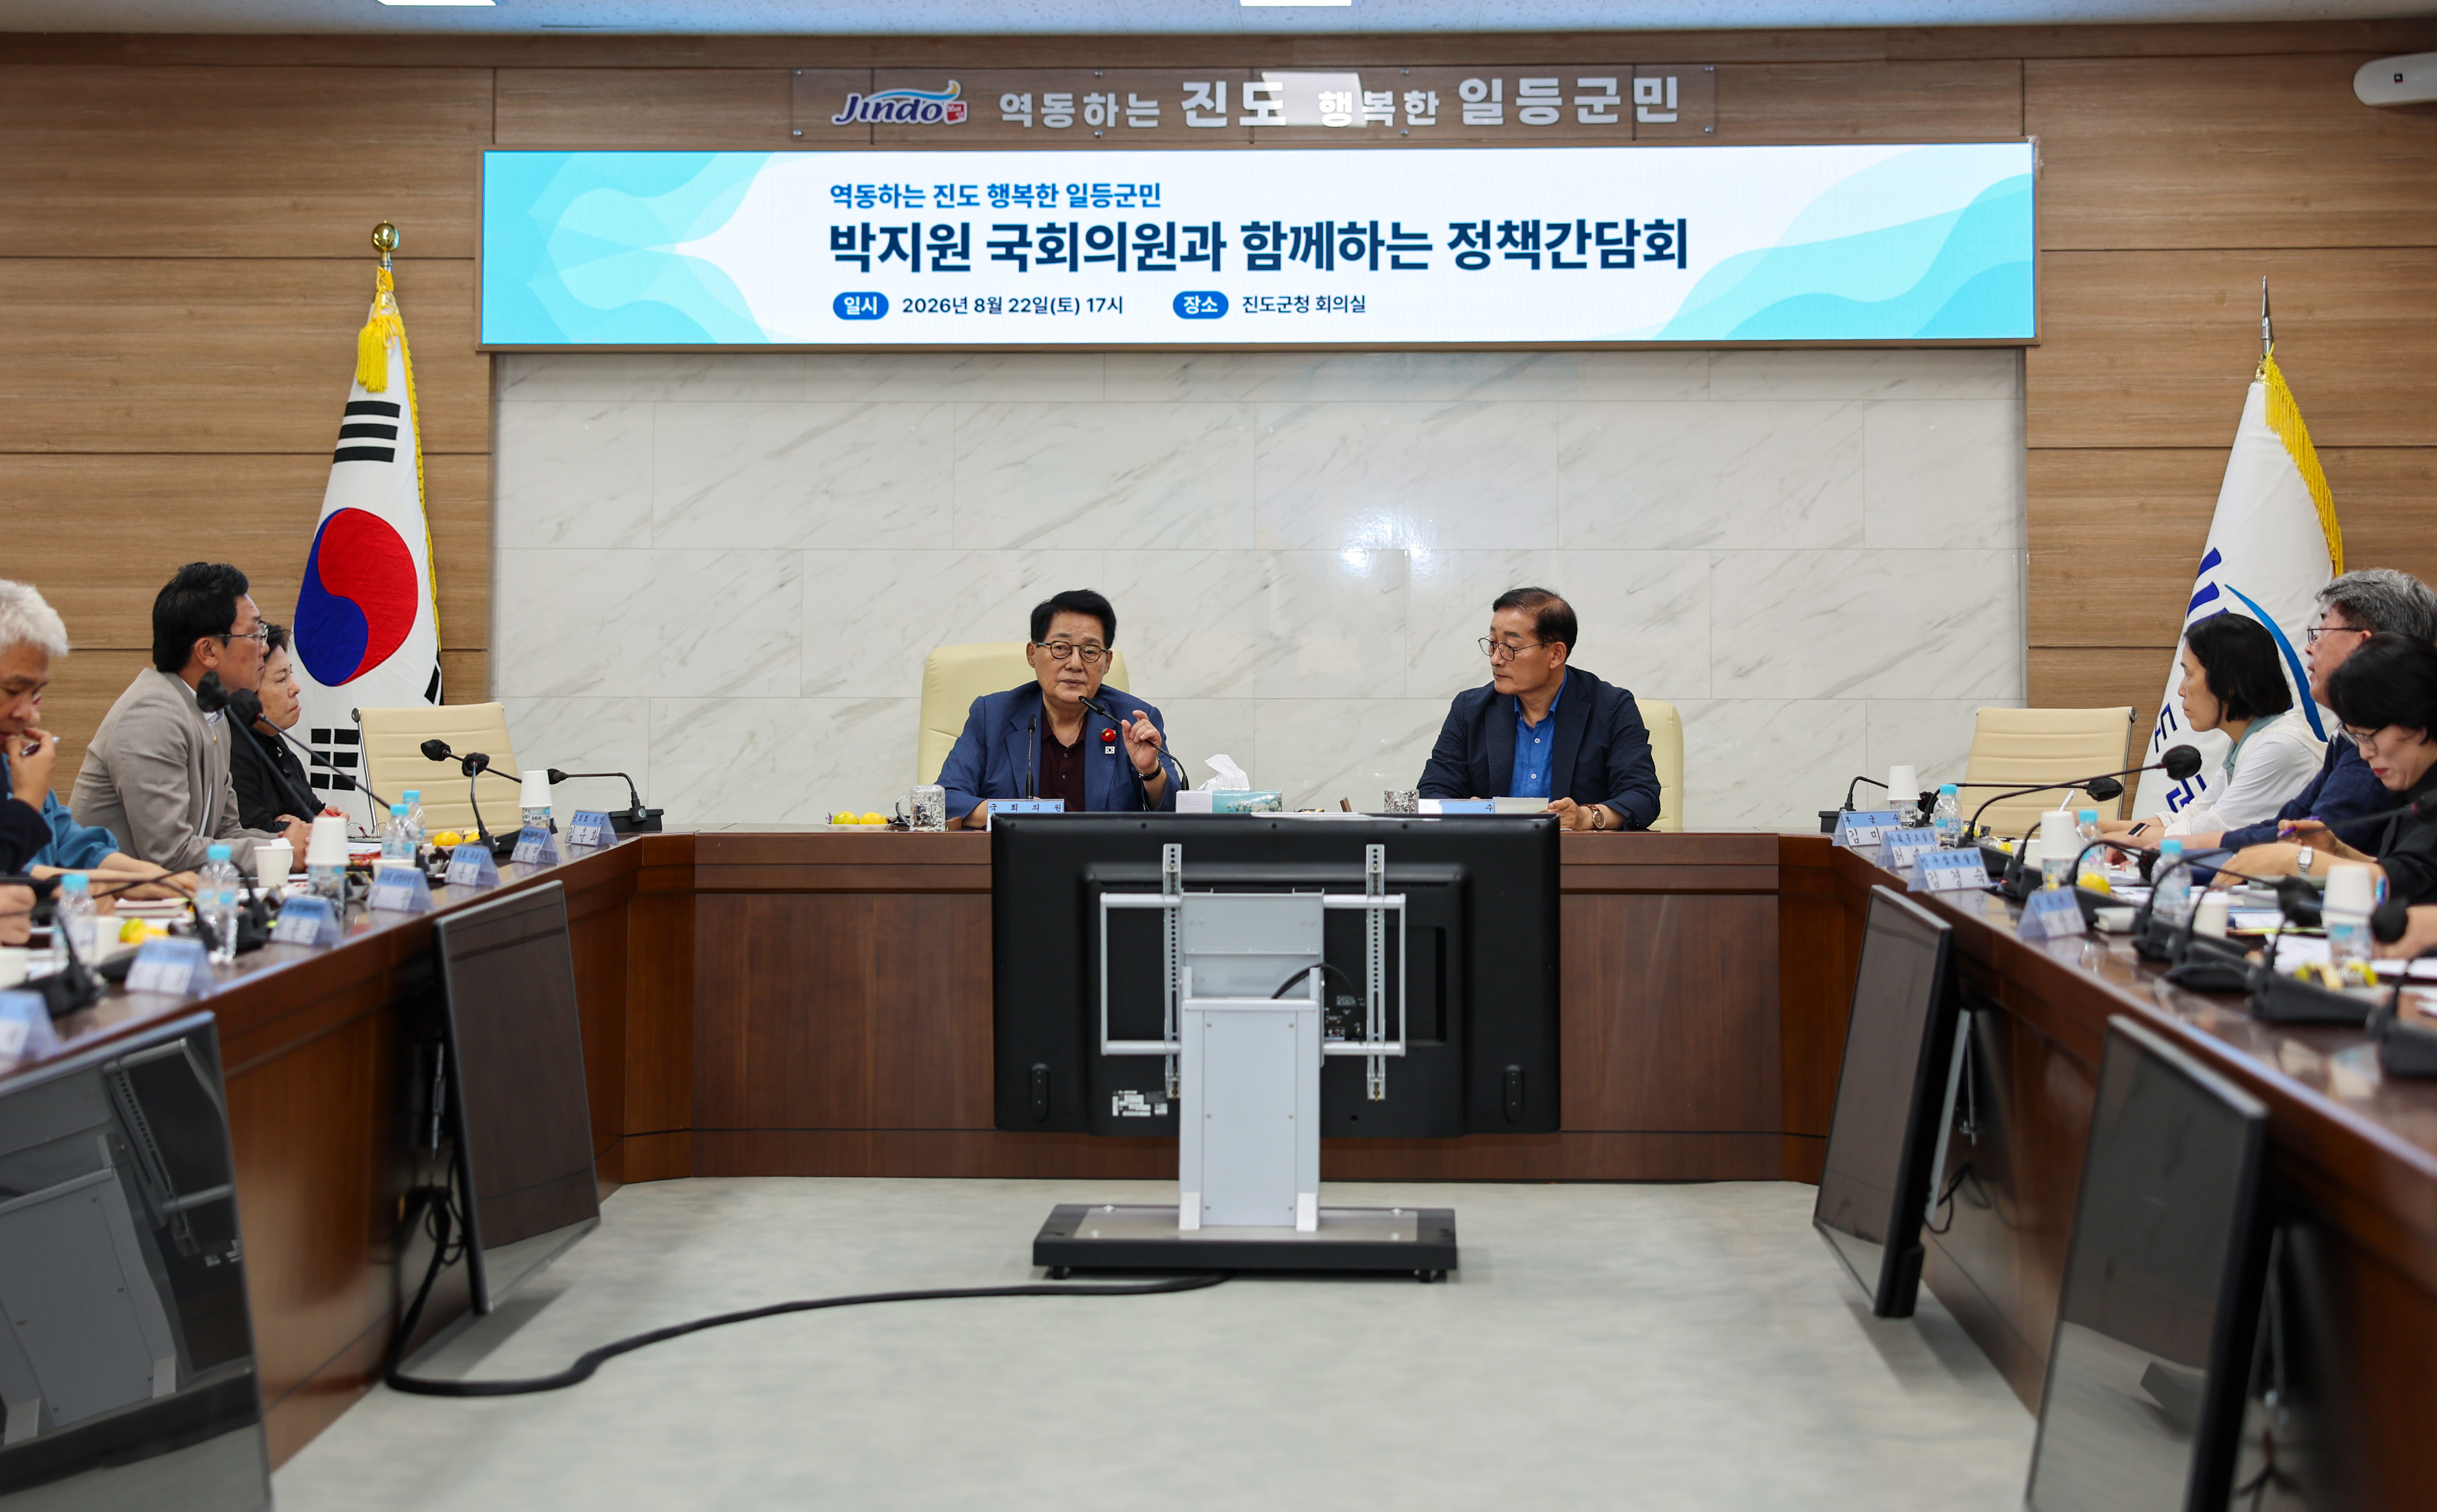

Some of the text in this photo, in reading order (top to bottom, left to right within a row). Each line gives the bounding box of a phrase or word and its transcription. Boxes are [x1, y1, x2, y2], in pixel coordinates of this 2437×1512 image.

[833, 94, 943, 123] Jindo
[999, 76, 1678, 128] 역동하는 진도 행복한 일등군민
[830, 182, 1161, 209] 역동하는 진도 행복한 일등군민
[830, 218, 1687, 273] 박지원 국회의원과 함께하는 정책간담회
[843, 296, 878, 315] 일시
[902, 296, 1123, 315] 2026년 8월 22일(토) 17시
[1183, 295, 1218, 315] 장소
[1242, 295, 1366, 313] 진도군청 회의실
[989, 803, 1061, 812] 국회의원
[1845, 813, 1900, 825] 부군수
[1848, 826, 1898, 844] 김미
